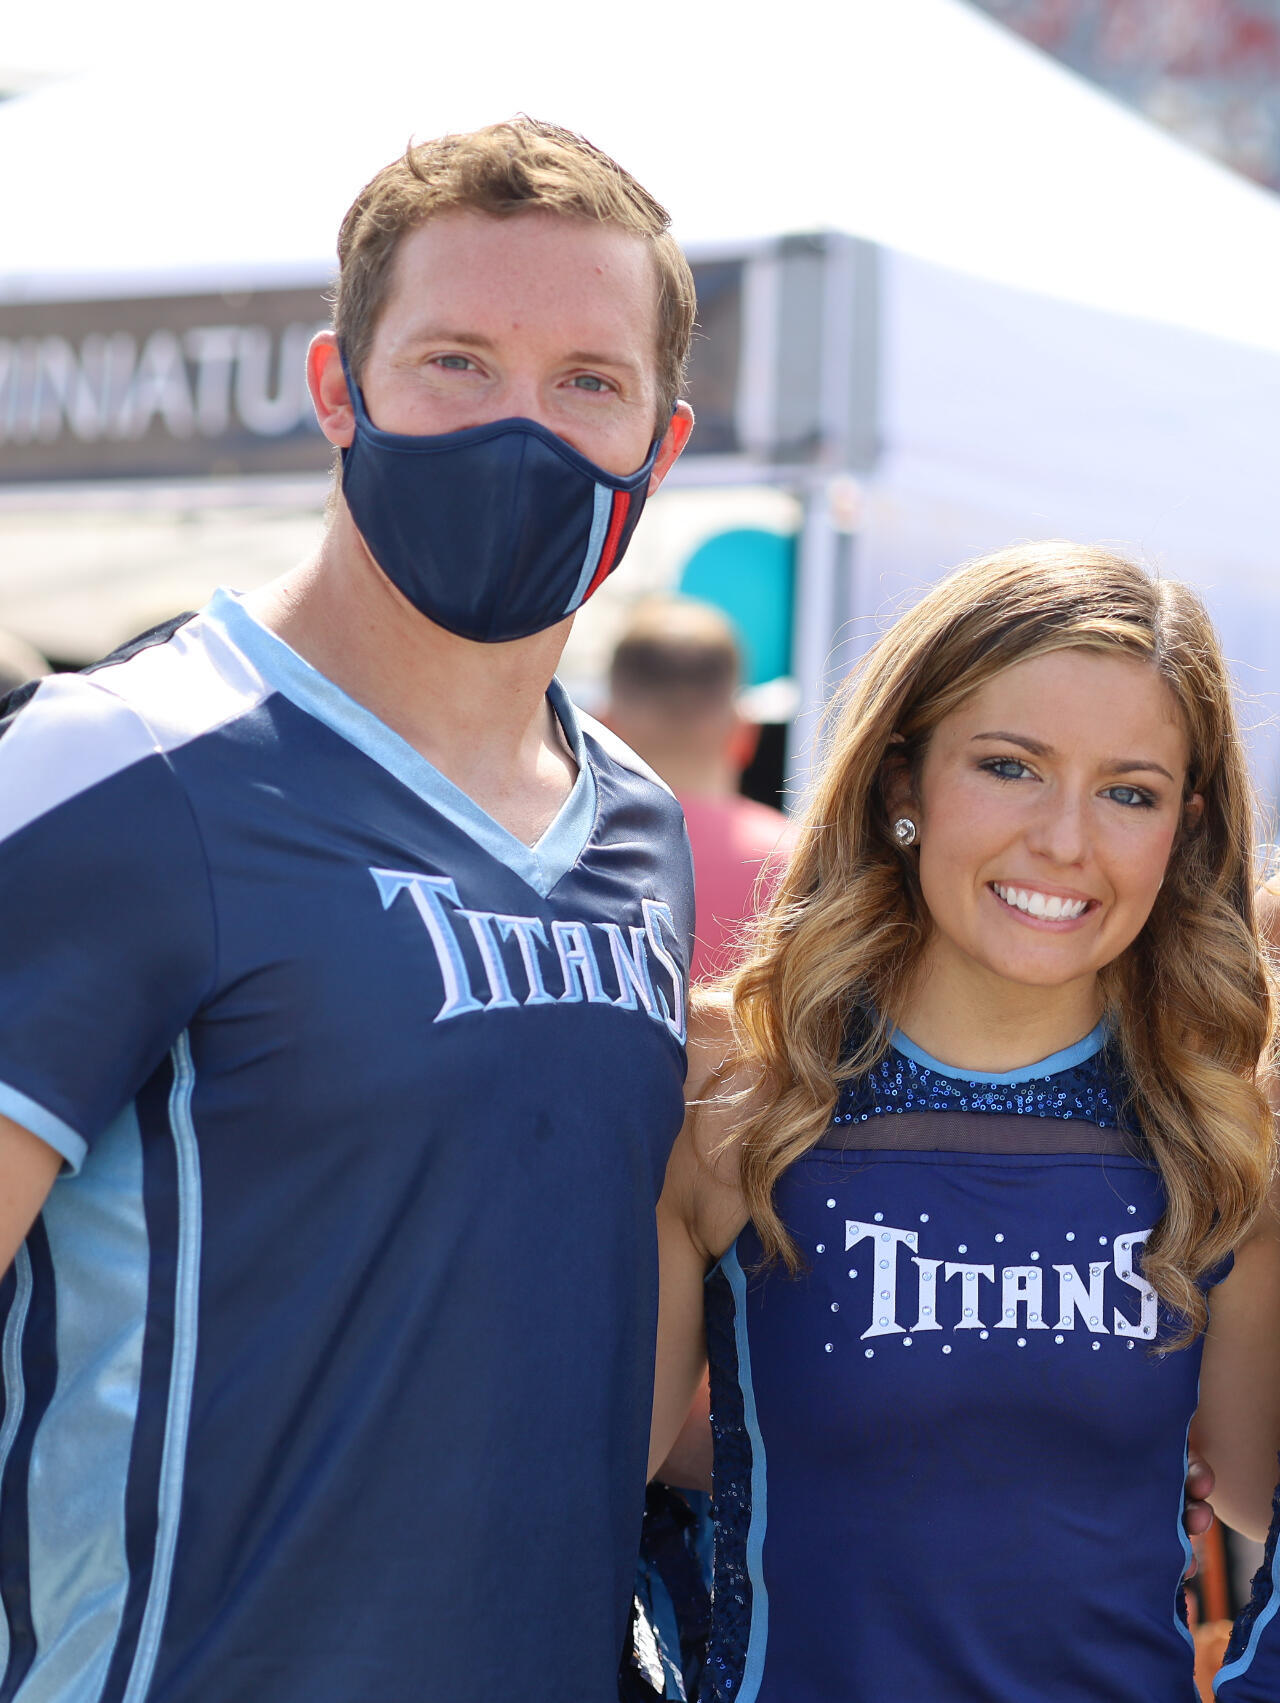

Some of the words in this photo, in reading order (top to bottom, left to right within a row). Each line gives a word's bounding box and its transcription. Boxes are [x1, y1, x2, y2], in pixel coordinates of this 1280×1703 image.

[0, 324, 332, 442] INIATU
[370, 867, 687, 1046] TITANS
[845, 1219, 1158, 1340] TITANS
